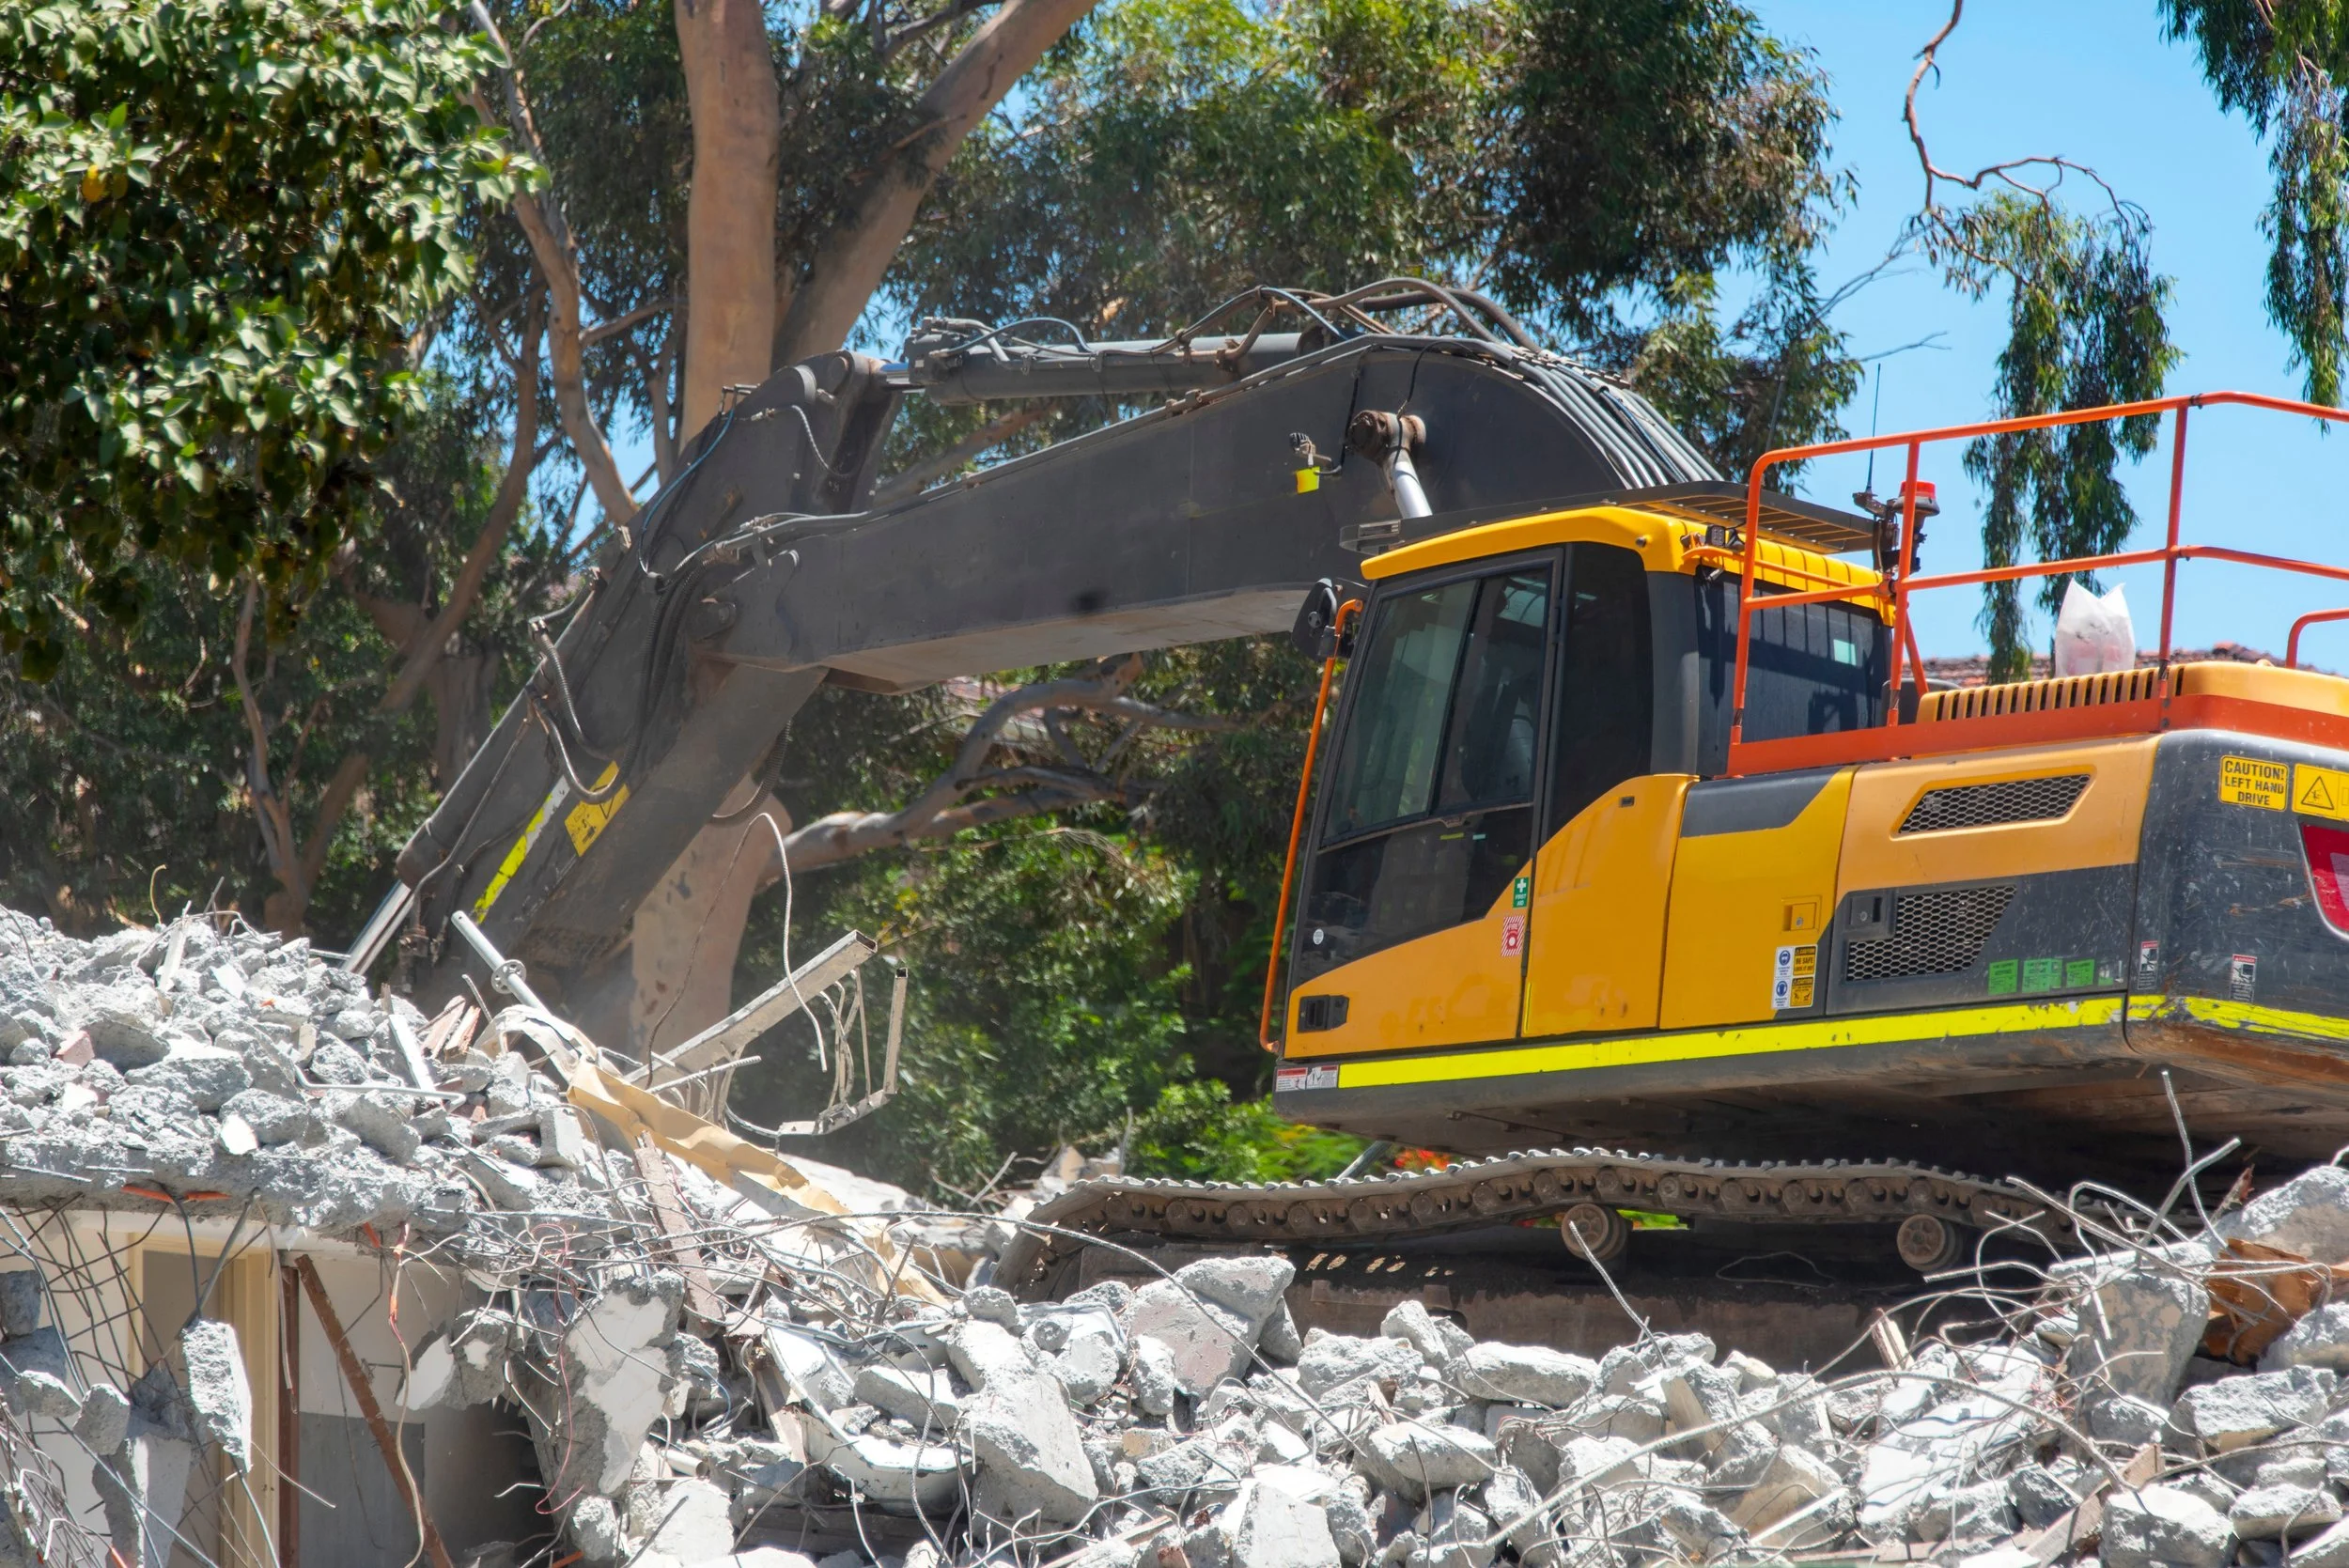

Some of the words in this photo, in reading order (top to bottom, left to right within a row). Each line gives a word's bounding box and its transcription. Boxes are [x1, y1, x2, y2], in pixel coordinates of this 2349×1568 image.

[2225, 760, 2284, 781] CAUTION!
[2225, 776, 2251, 789] LEFT
[2255, 780, 2284, 794] HAND
[2237, 791, 2270, 805] DRIVE
